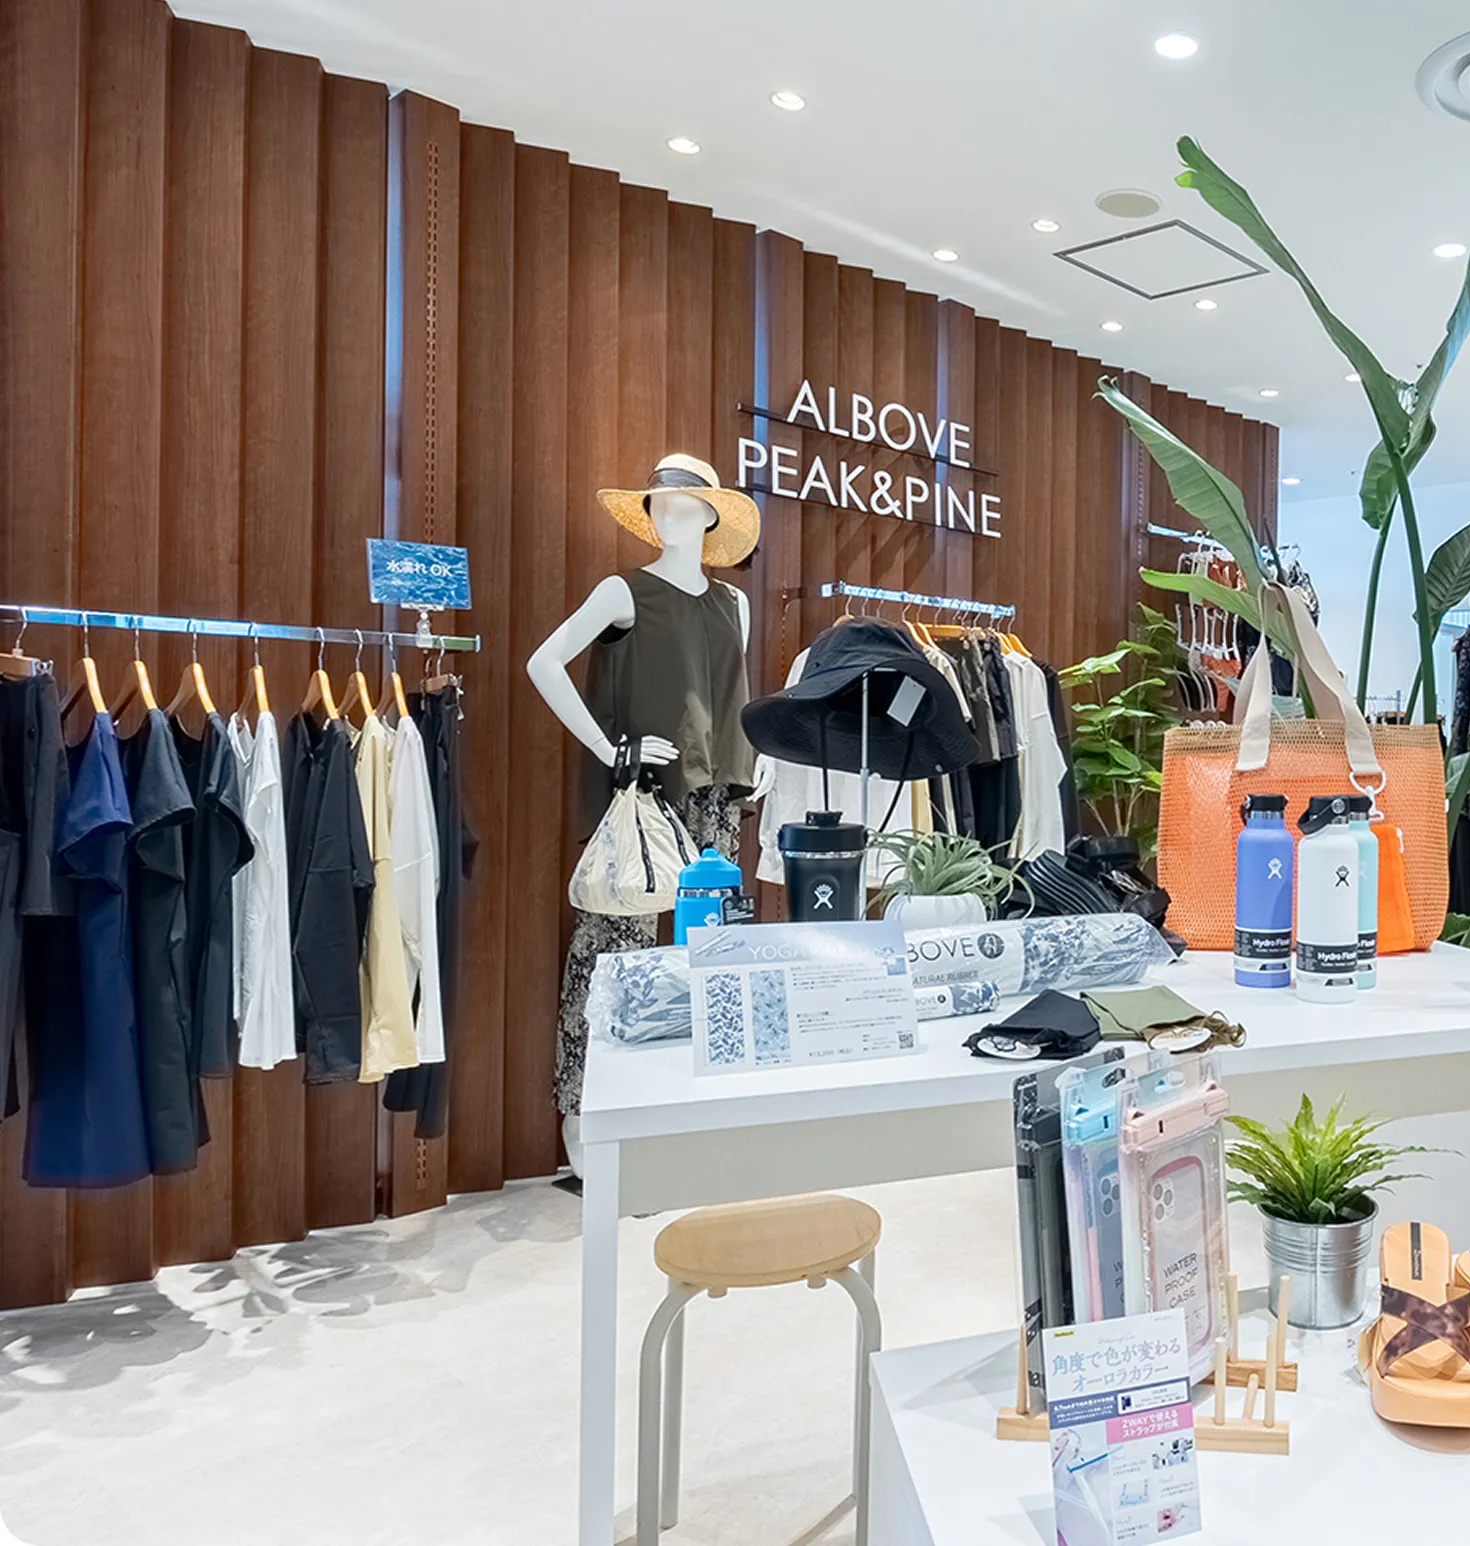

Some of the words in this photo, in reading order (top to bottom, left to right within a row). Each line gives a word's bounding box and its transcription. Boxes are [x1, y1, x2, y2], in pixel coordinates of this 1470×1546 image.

[786, 379, 971, 469] ALBOVE
[738, 437, 1002, 539] PEAK&PINE
[430, 563, 452, 577] OK
[907, 937, 975, 963] BOVE
[1317, 951, 1342, 963] Hydro
[912, 973, 946, 986] ATURAL
[1163, 1252, 1198, 1278] WATER
[1164, 1267, 1199, 1294] PROOF
[1168, 1286, 1197, 1308] CASE
[1052, 1337, 1181, 1376] 角度で色が変わる
[1072, 1364, 1169, 1392] オーロラカラー
[1121, 1409, 1179, 1429] 2WAYで使える
